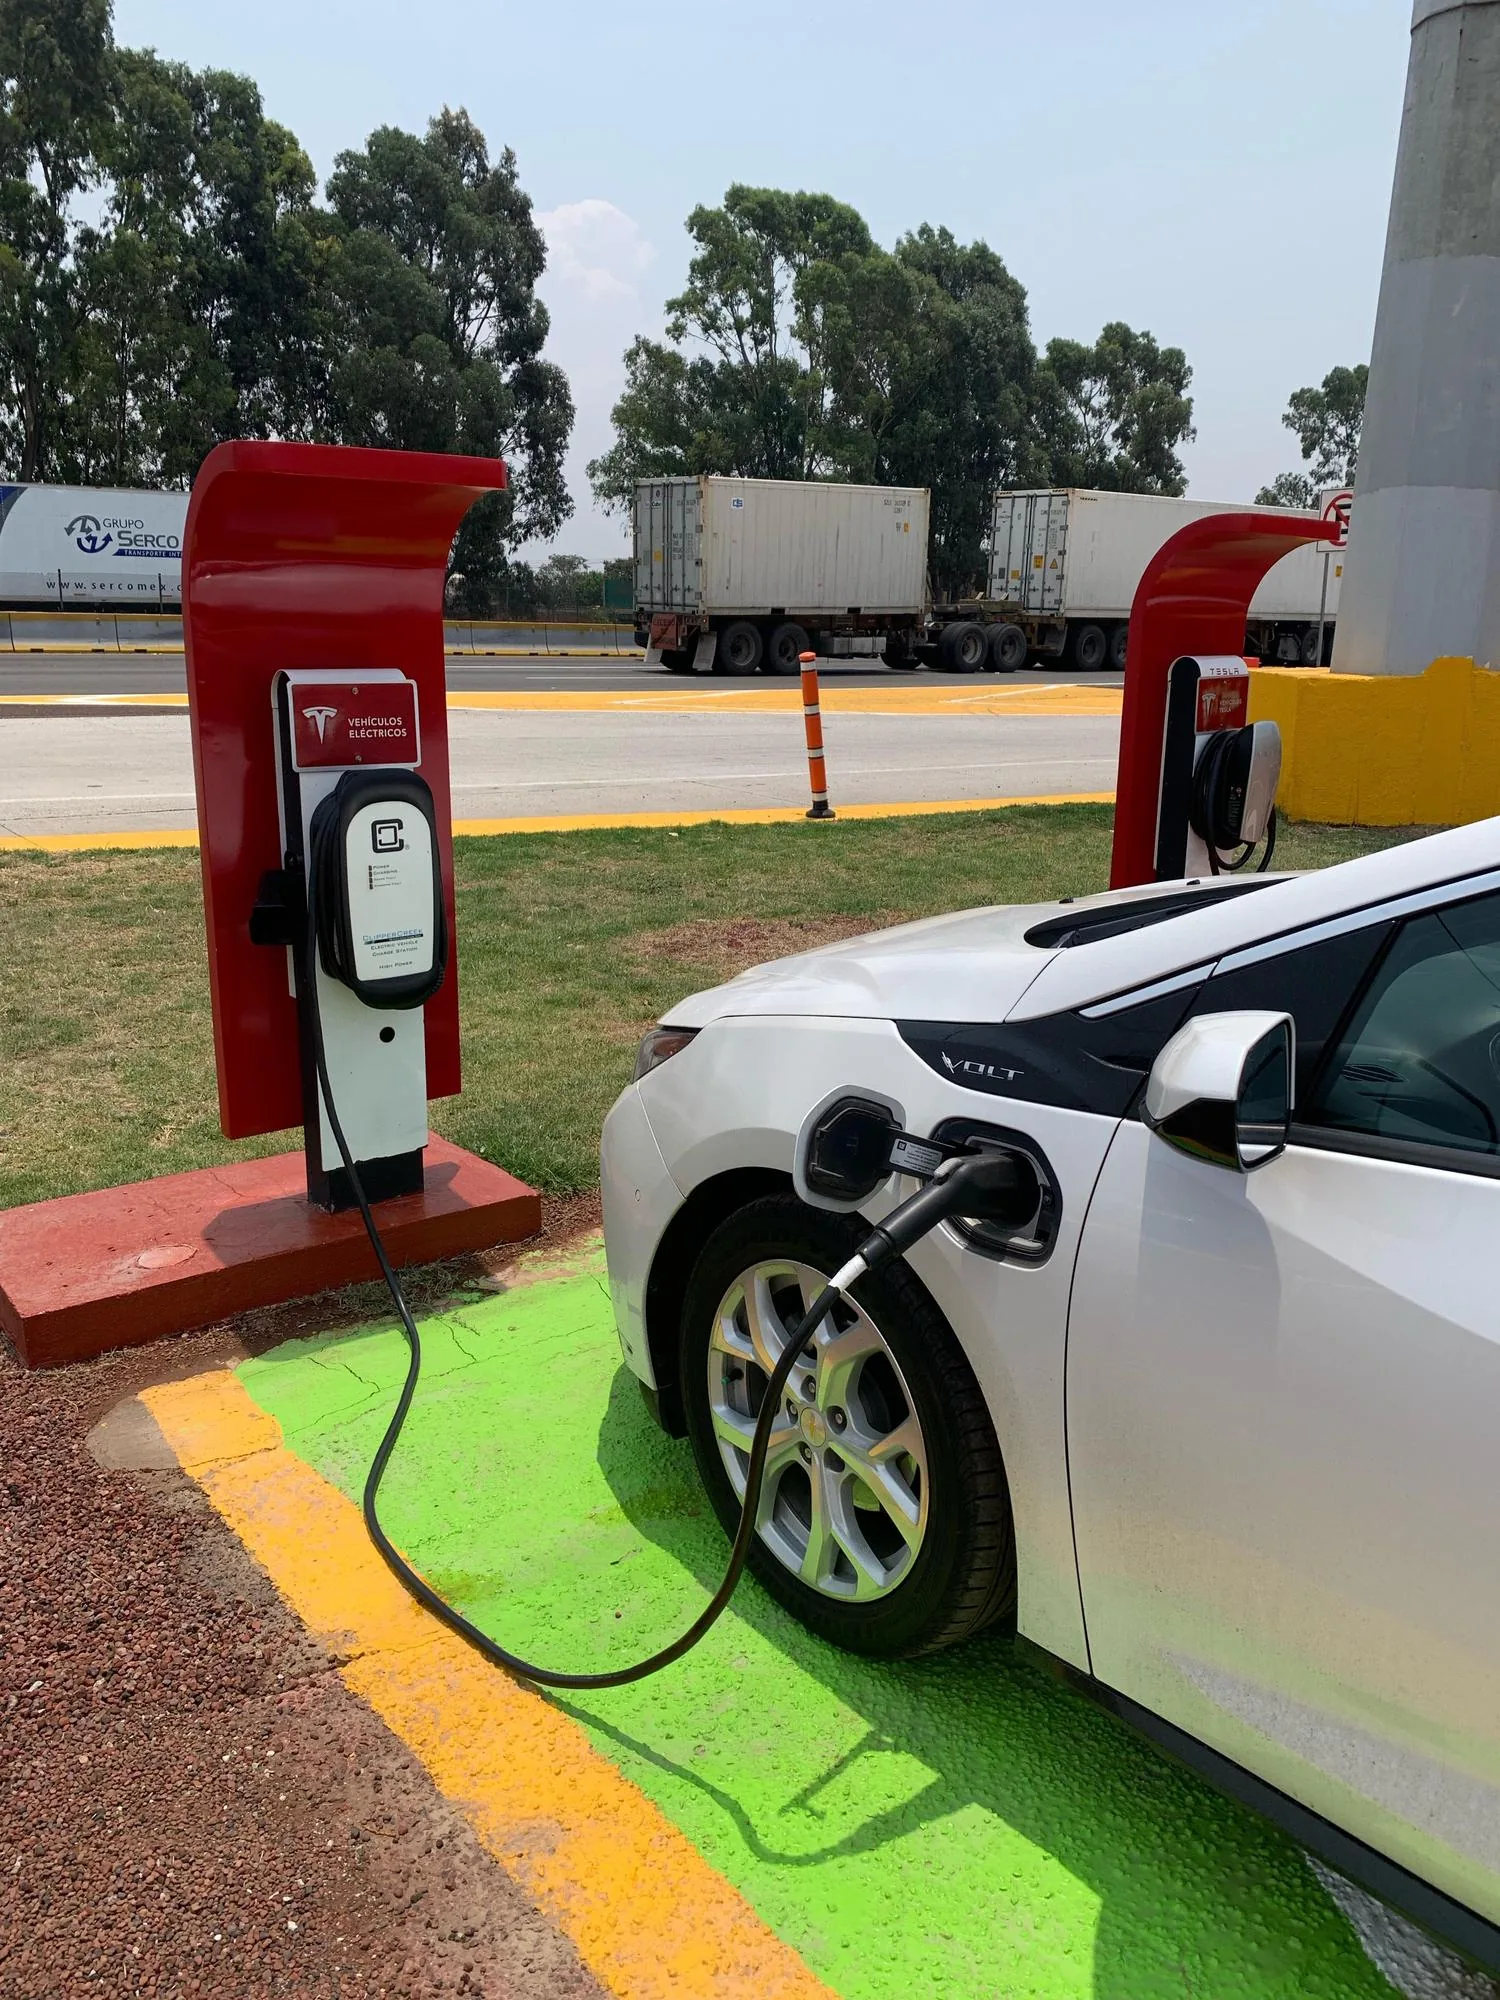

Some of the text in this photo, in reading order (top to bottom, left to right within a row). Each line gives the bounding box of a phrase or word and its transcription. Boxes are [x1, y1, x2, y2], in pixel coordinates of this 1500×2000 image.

[103, 519, 144, 529] GRUPO
[348, 716, 403, 727] VEHÍCULOS
[350, 728, 407, 739] ELÉCTRICOS
[942, 1051, 1025, 1081] VOLT
